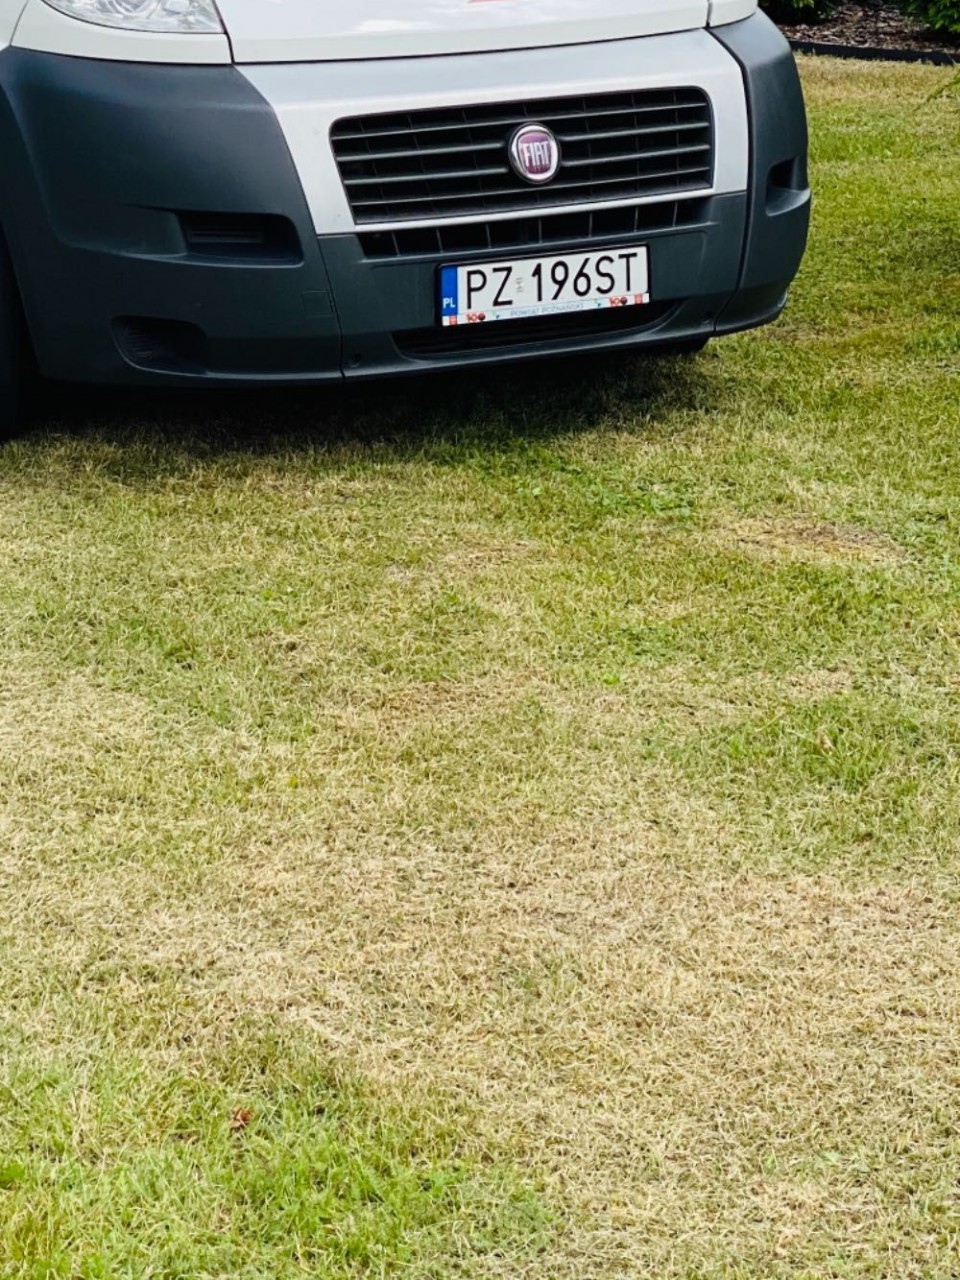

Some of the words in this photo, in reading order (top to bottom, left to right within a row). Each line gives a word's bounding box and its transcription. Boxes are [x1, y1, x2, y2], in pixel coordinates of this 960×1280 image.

[522, 141, 549, 167] FIAT
[466, 266, 513, 309] PZ
[531, 252, 638, 302] 196ST
[442, 297, 456, 309] PL
